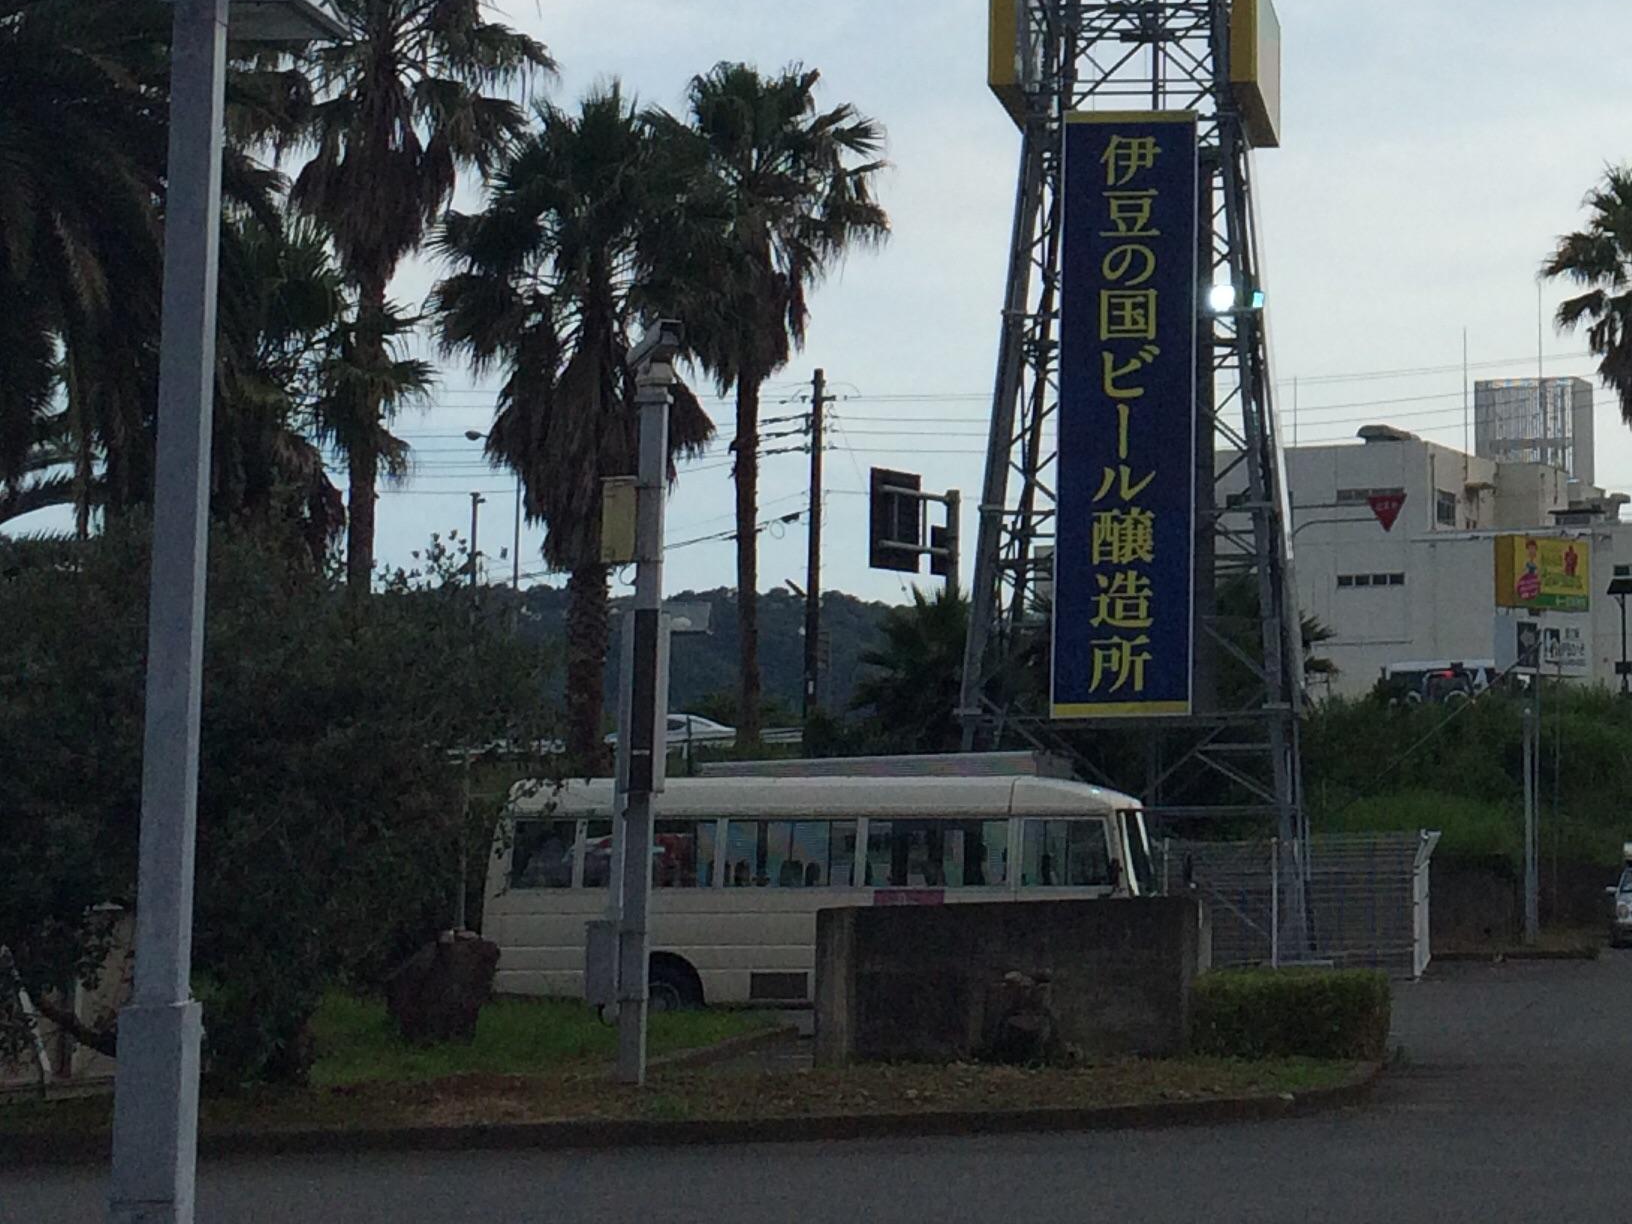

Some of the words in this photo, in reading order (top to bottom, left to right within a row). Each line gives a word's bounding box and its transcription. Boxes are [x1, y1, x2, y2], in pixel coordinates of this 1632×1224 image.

[1088, 134, 1162, 694] 伊豆の国ビール醸造所
